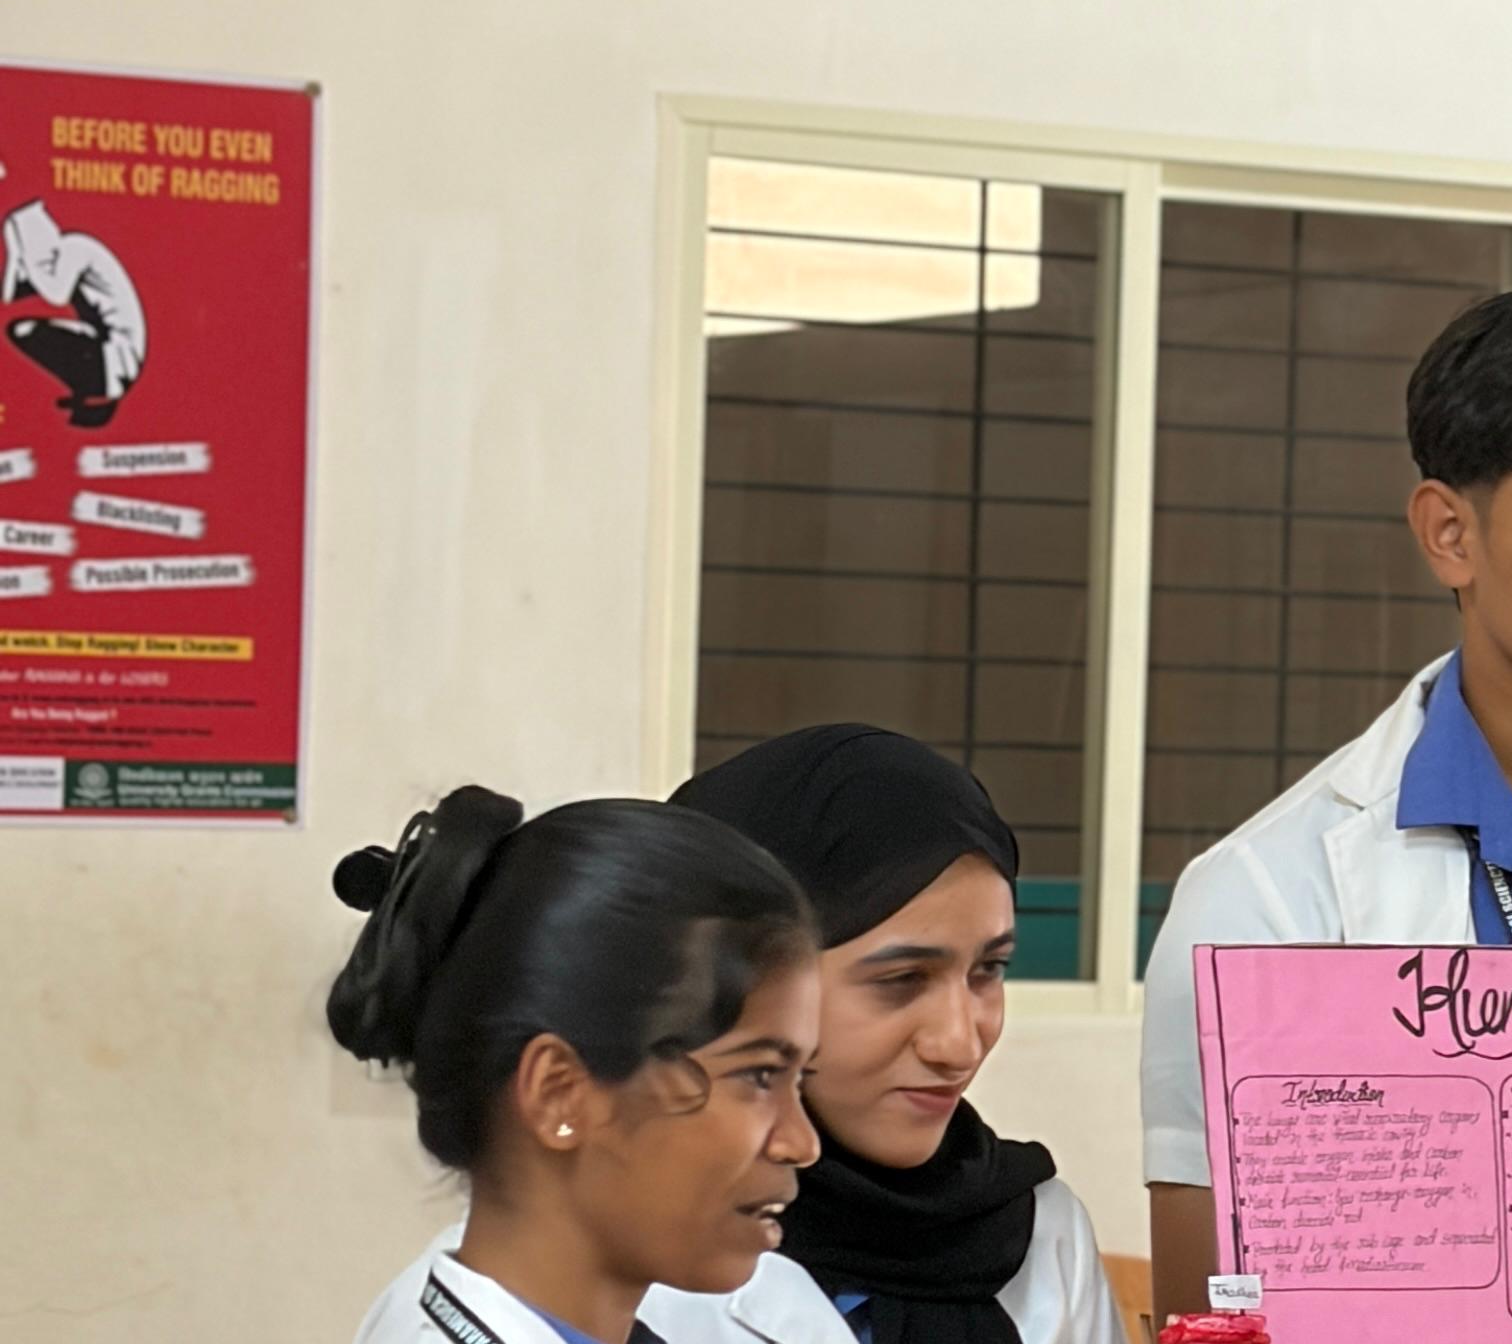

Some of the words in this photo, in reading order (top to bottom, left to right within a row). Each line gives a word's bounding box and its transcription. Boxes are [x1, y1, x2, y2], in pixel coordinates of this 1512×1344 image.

[51, 116, 147, 153] BEFORE
[153, 124, 202, 157] YOU
[209, 128, 273, 163] EVEN
[51, 158, 126, 194] THINK
[132, 164, 164, 197] OF
[170, 167, 280, 206] RAGGING
[103, 450, 187, 469] Suspension
[97, 500, 182, 532] Blacklisting
[3, 525, 55, 546] Career
[85, 565, 147, 583] Possible
[153, 562, 240, 582] Prosecution
